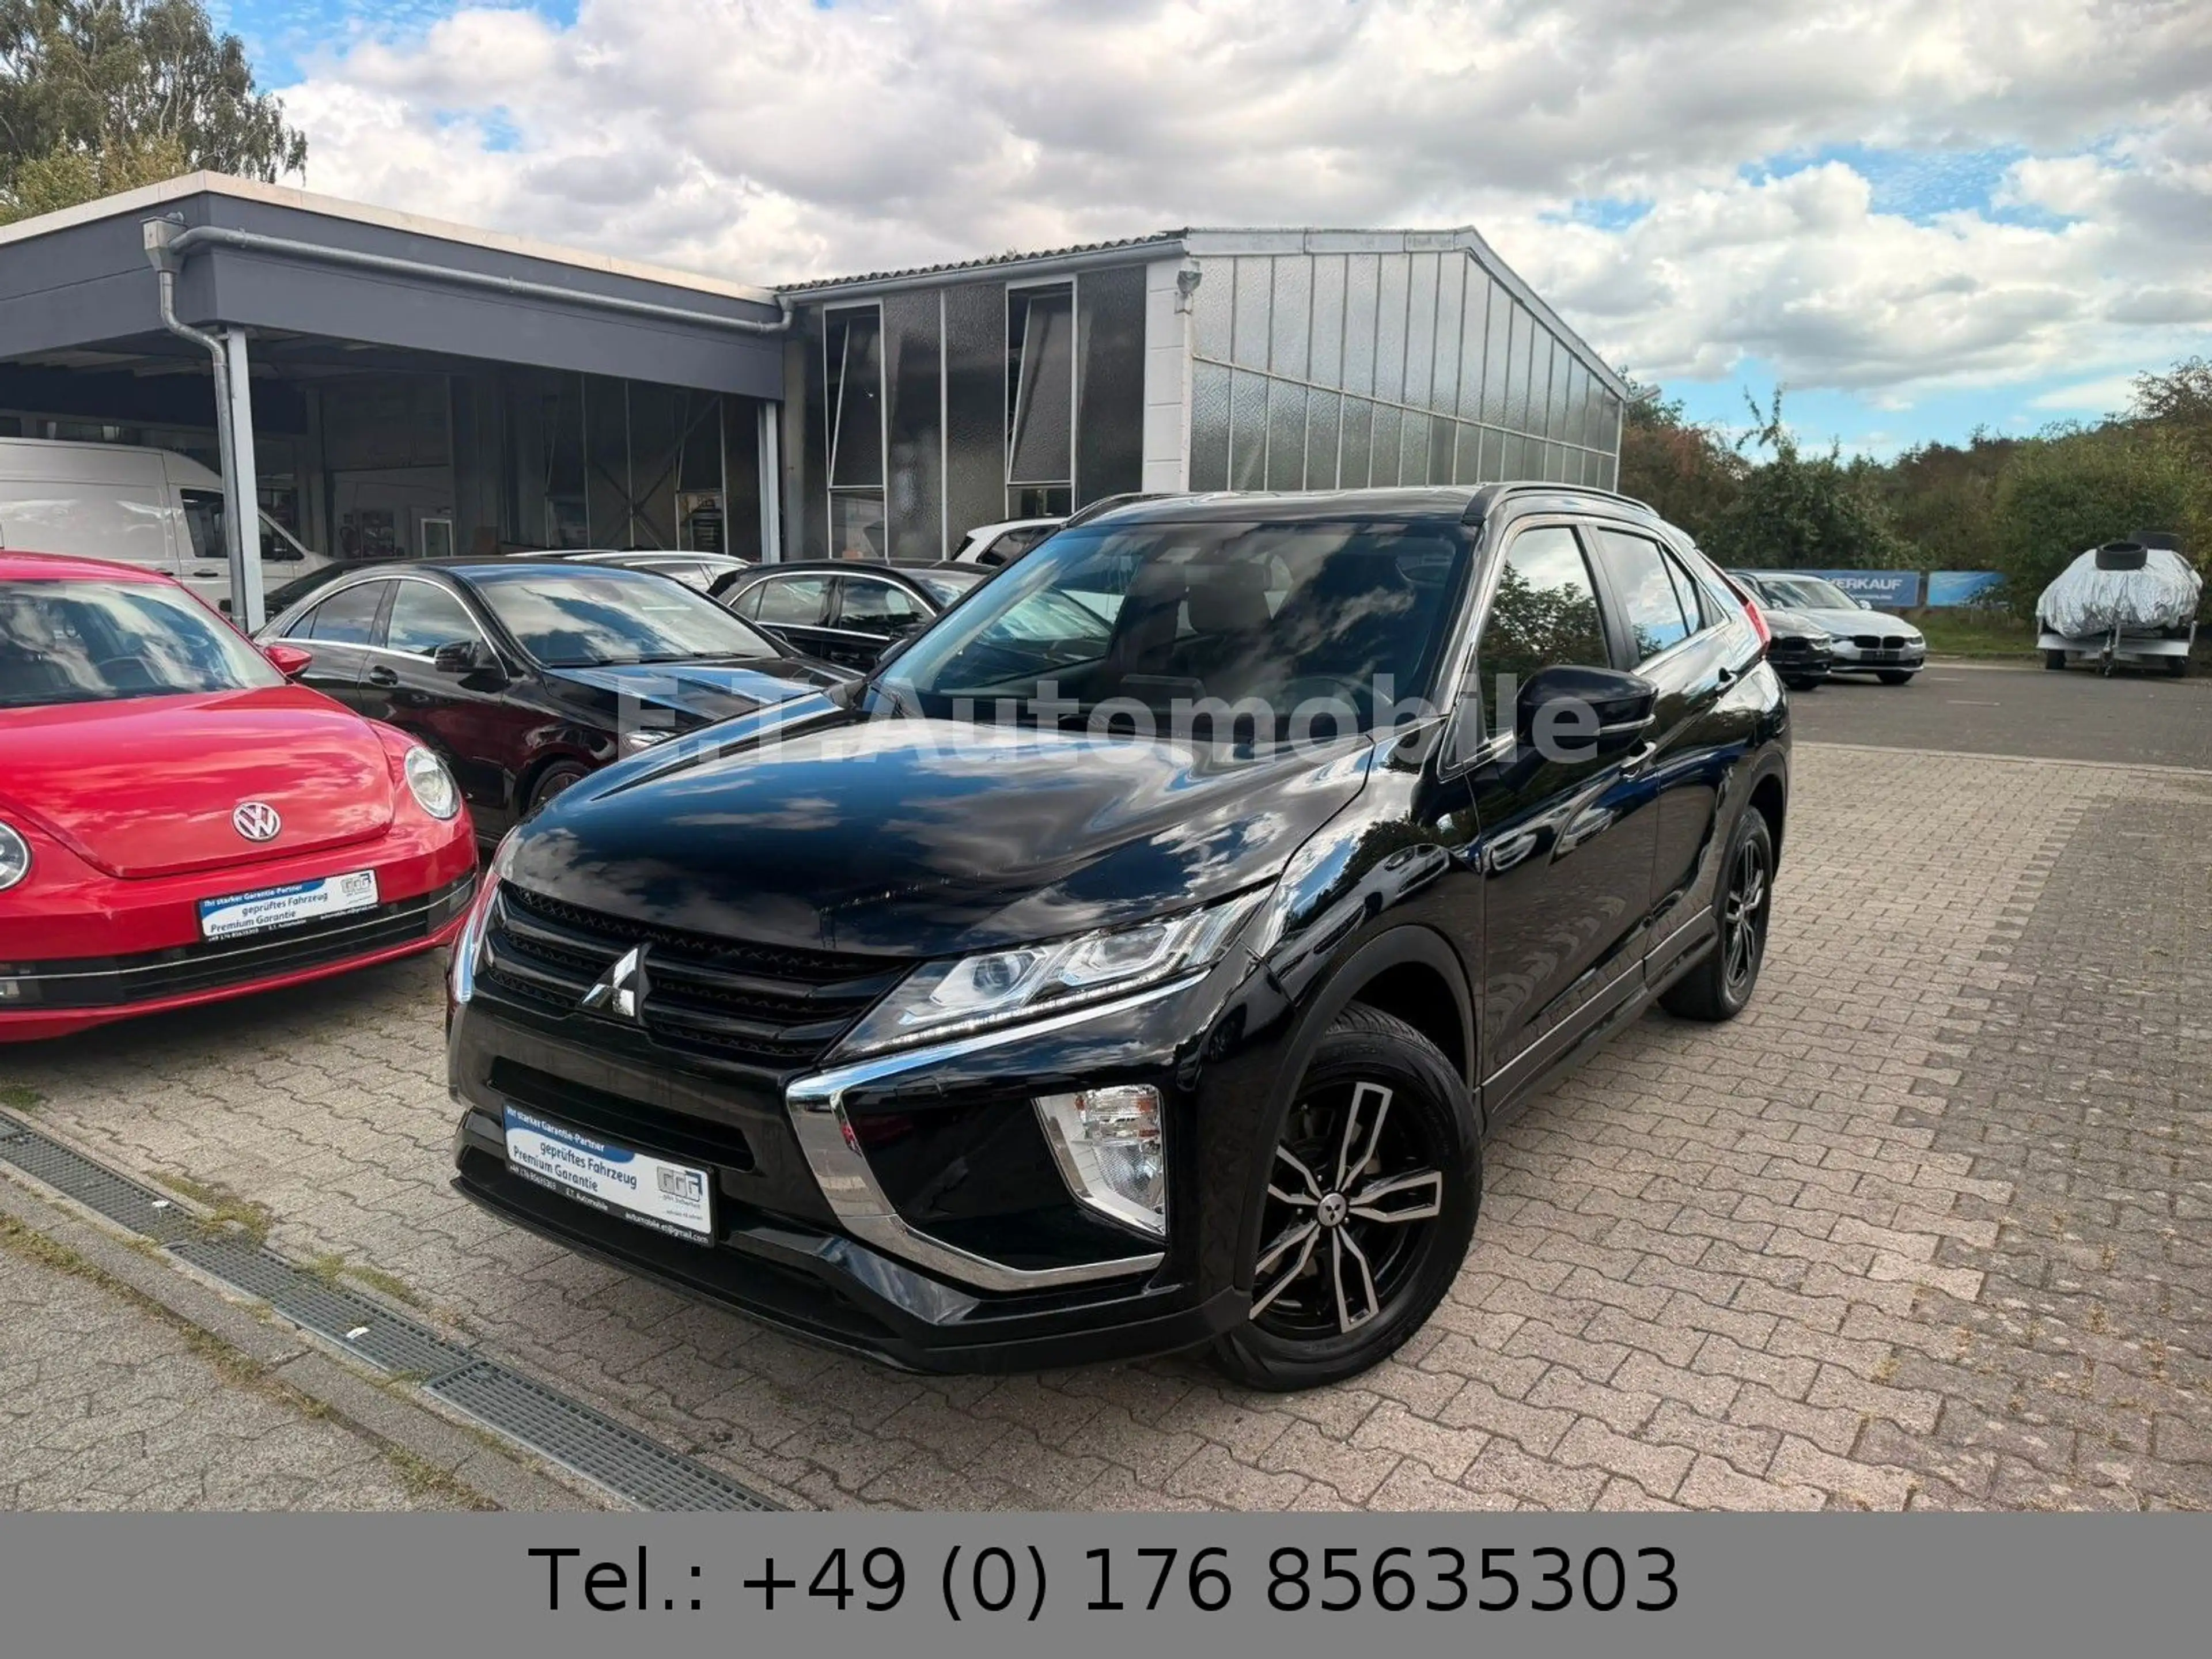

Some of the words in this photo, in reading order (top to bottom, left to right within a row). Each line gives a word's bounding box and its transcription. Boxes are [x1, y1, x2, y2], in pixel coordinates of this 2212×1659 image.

[210, 919, 254, 933] Premium
[255, 910, 297, 925] Garantie
[241, 899, 286, 916] geprüftes
[287, 892, 328, 907] Fahrzeug
[513, 1145, 554, 1173] Premium
[555, 1164, 599, 1192] Garantie
[540, 1142, 586, 1168] geprüftes
[588, 1158, 637, 1190] Fahrzeug
